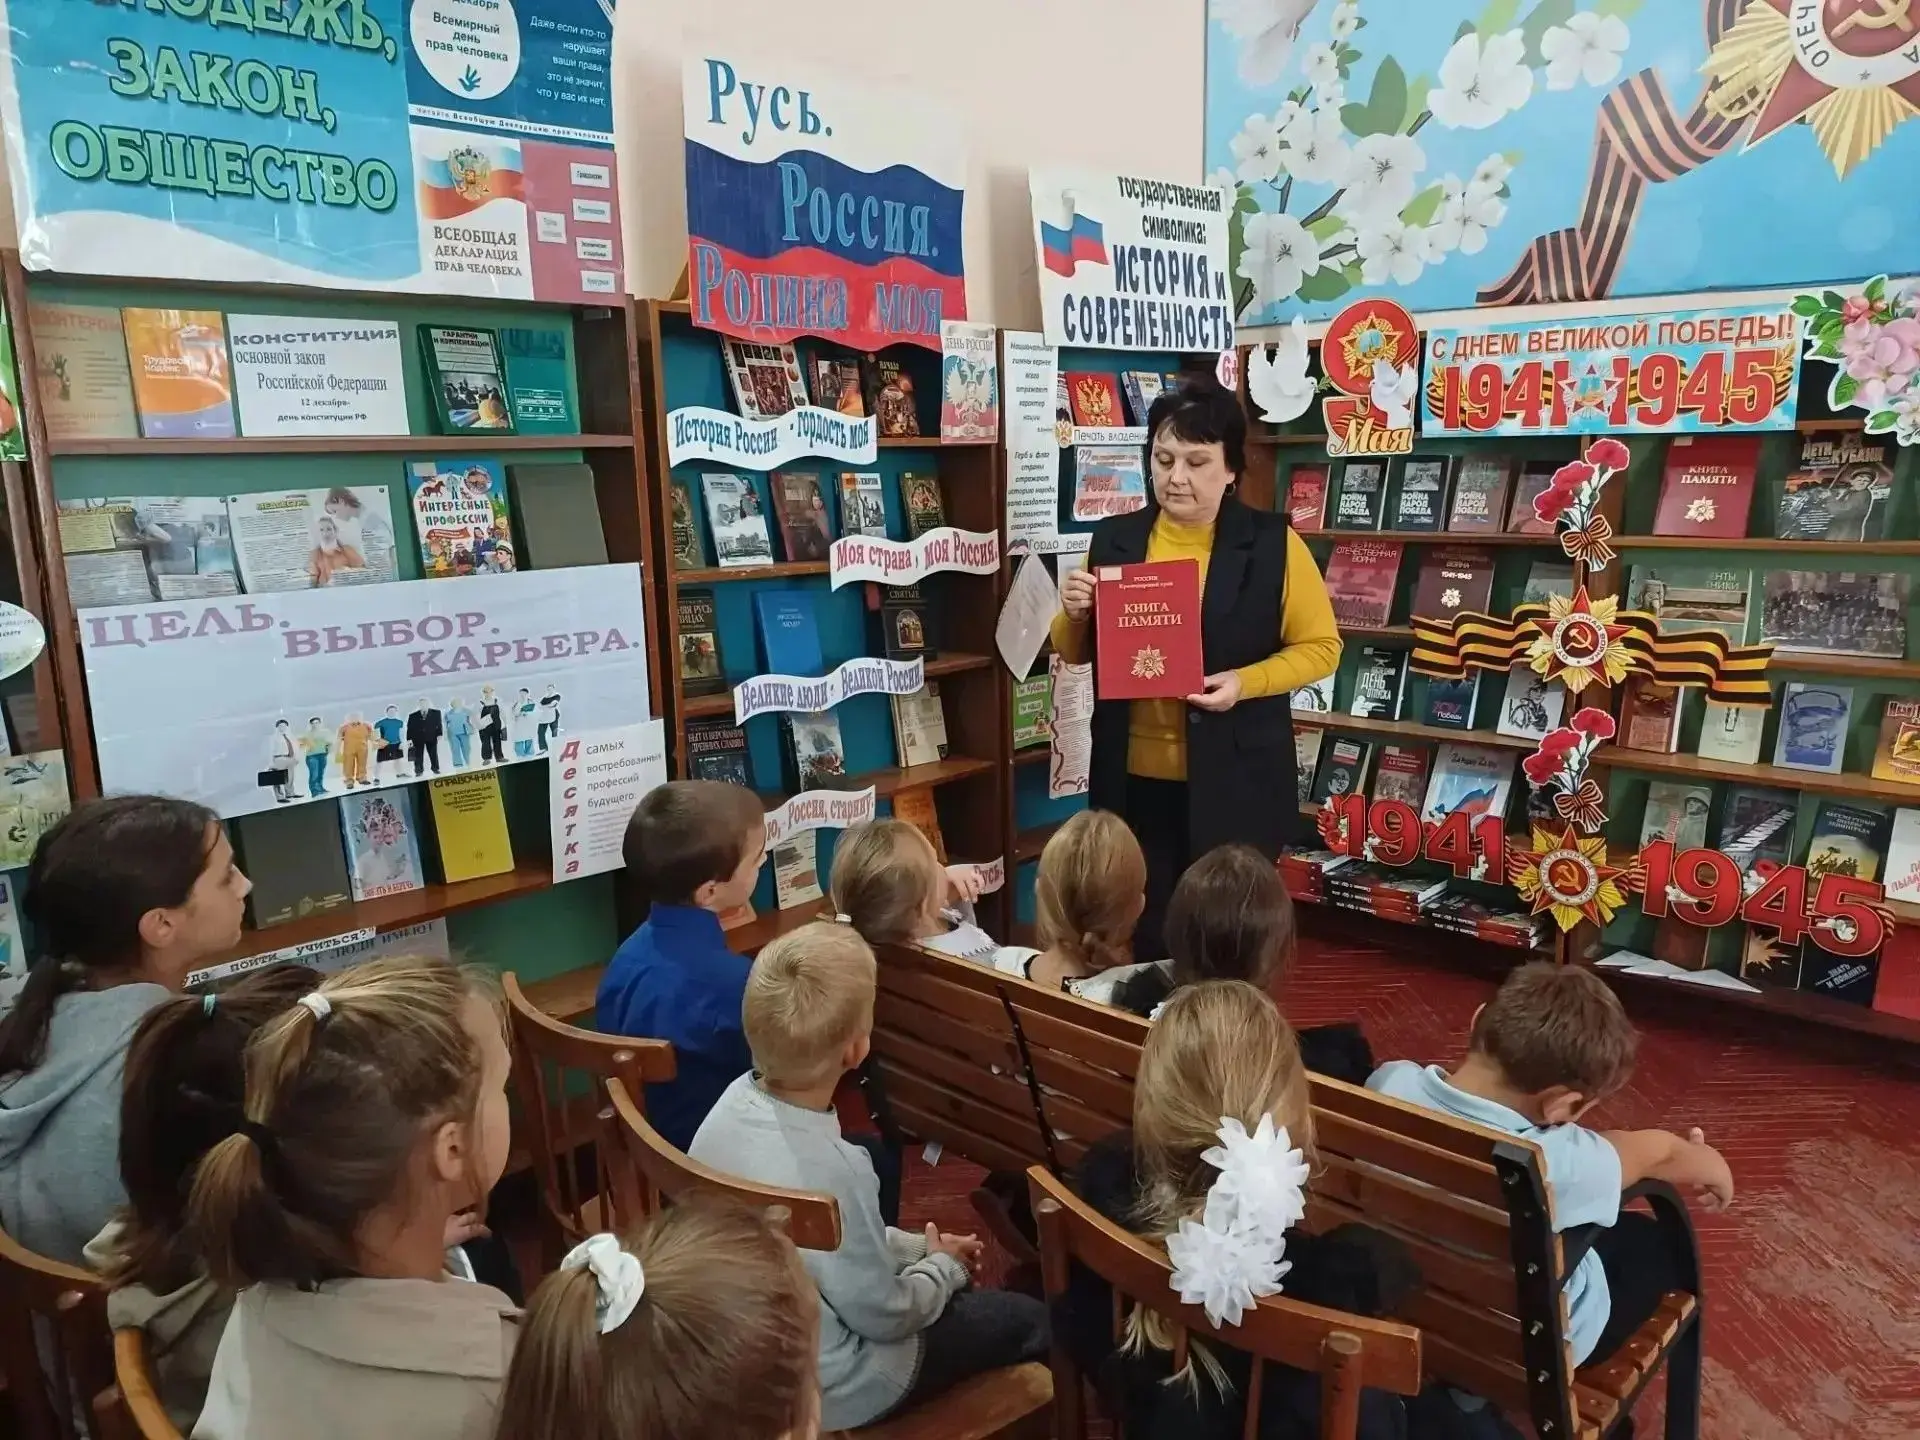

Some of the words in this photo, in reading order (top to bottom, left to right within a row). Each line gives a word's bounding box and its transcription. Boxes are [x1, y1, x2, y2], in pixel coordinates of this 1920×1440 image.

[433, 12, 500, 35] Всемирный
[530, 16, 555, 29] Даже
[557, 23, 578, 34] если
[453, 32, 481, 45] день
[426, 40, 453, 53] прав
[457, 44, 508, 62] человека
[563, 42, 606, 56] нарушает
[553, 56, 576, 67] ваши
[107, 37, 336, 133] ЗАКОН,
[547, 73, 562, 82] это
[564, 75, 573, 84] не
[537, 88, 552, 97] что
[554, 91, 559, 101] у
[561, 92, 576, 101] вас
[578, 95, 588, 104] их
[704, 59, 833, 145] Русь.
[50, 119, 398, 211] ОБЩЕСТВО
[777, 162, 939, 258] Россия.
[434, 225, 517, 246] ВСЕОБЩАЯ
[1142, 214, 1207, 245] символика:
[435, 245, 518, 262] ДЕКЛАРАЦИЯ
[435, 261, 464, 272] ПРАВ
[466, 263, 522, 277] ЧЕЛОВЕКА
[1112, 244, 1208, 299] ИСТОРИЯ
[696, 243, 847, 331] Родина
[875, 281, 943, 335] моя
[1064, 292, 1233, 349] СОВРЕМЕННОСТЬ
[233, 329, 397, 346] КОНСТИТУЦИЯ
[442, 331, 478, 340] ГАРАНТИИ
[1432, 337, 1447, 360] С
[1453, 331, 1519, 362] ДНЕМ
[1528, 320, 1650, 355] ВЕЛИКОЙ
[1658, 314, 1794, 347] ПОБЕДЫ!
[236, 349, 291, 365] основной
[295, 353, 325, 365] закон
[257, 372, 324, 390] Российской
[327, 373, 388, 395] Федерации
[1443, 357, 1571, 433] 1941
[1607, 348, 1778, 428] 1945
[278, 414, 298, 422] день
[301, 413, 353, 422] конституции
[355, 413, 367, 421] РФ
[675, 413, 731, 452] История
[735, 421, 777, 455] России
[797, 411, 846, 449] гордость
[850, 420, 869, 450] моя
[1074, 429, 1105, 442] Печать
[1329, 416, 1412, 455] Мая
[1680, 473, 1737, 485] ПАМЯТИ
[1688, 465, 1729, 475] КНИГА
[1340, 501, 1366, 509] НАРОД
[1341, 493, 1368, 502] ВОЙНА
[425, 514, 488, 526] ПРОФЕССИИ
[1339, 507, 1370, 516] ПОБЕДА
[837, 540, 864, 572] Моя
[924, 538, 949, 570] моя
[953, 531, 998, 567] Россия.
[1124, 602, 1170, 614] КНИГА
[85, 604, 291, 649] ЦЕЛЬ.
[1117, 614, 1182, 627] ПАМЯТИ
[283, 611, 501, 659] ВЫБОР.
[408, 626, 639, 678] КАРЬЕРА.
[741, 682, 794, 716] Великие
[797, 681, 828, 711] люди
[841, 660, 884, 699] Великой
[1361, 672, 1386, 690] ДЕНЬ
[586, 740, 625, 755] самых
[434, 771, 496, 788] СПРАВОЧНИК
[588, 773, 640, 792] профессий
[788, 799, 828, 832] Россия,
[1337, 794, 1504, 885] 1941
[1638, 839, 1885, 957] 1945
[230, 952, 278, 972] пойти
